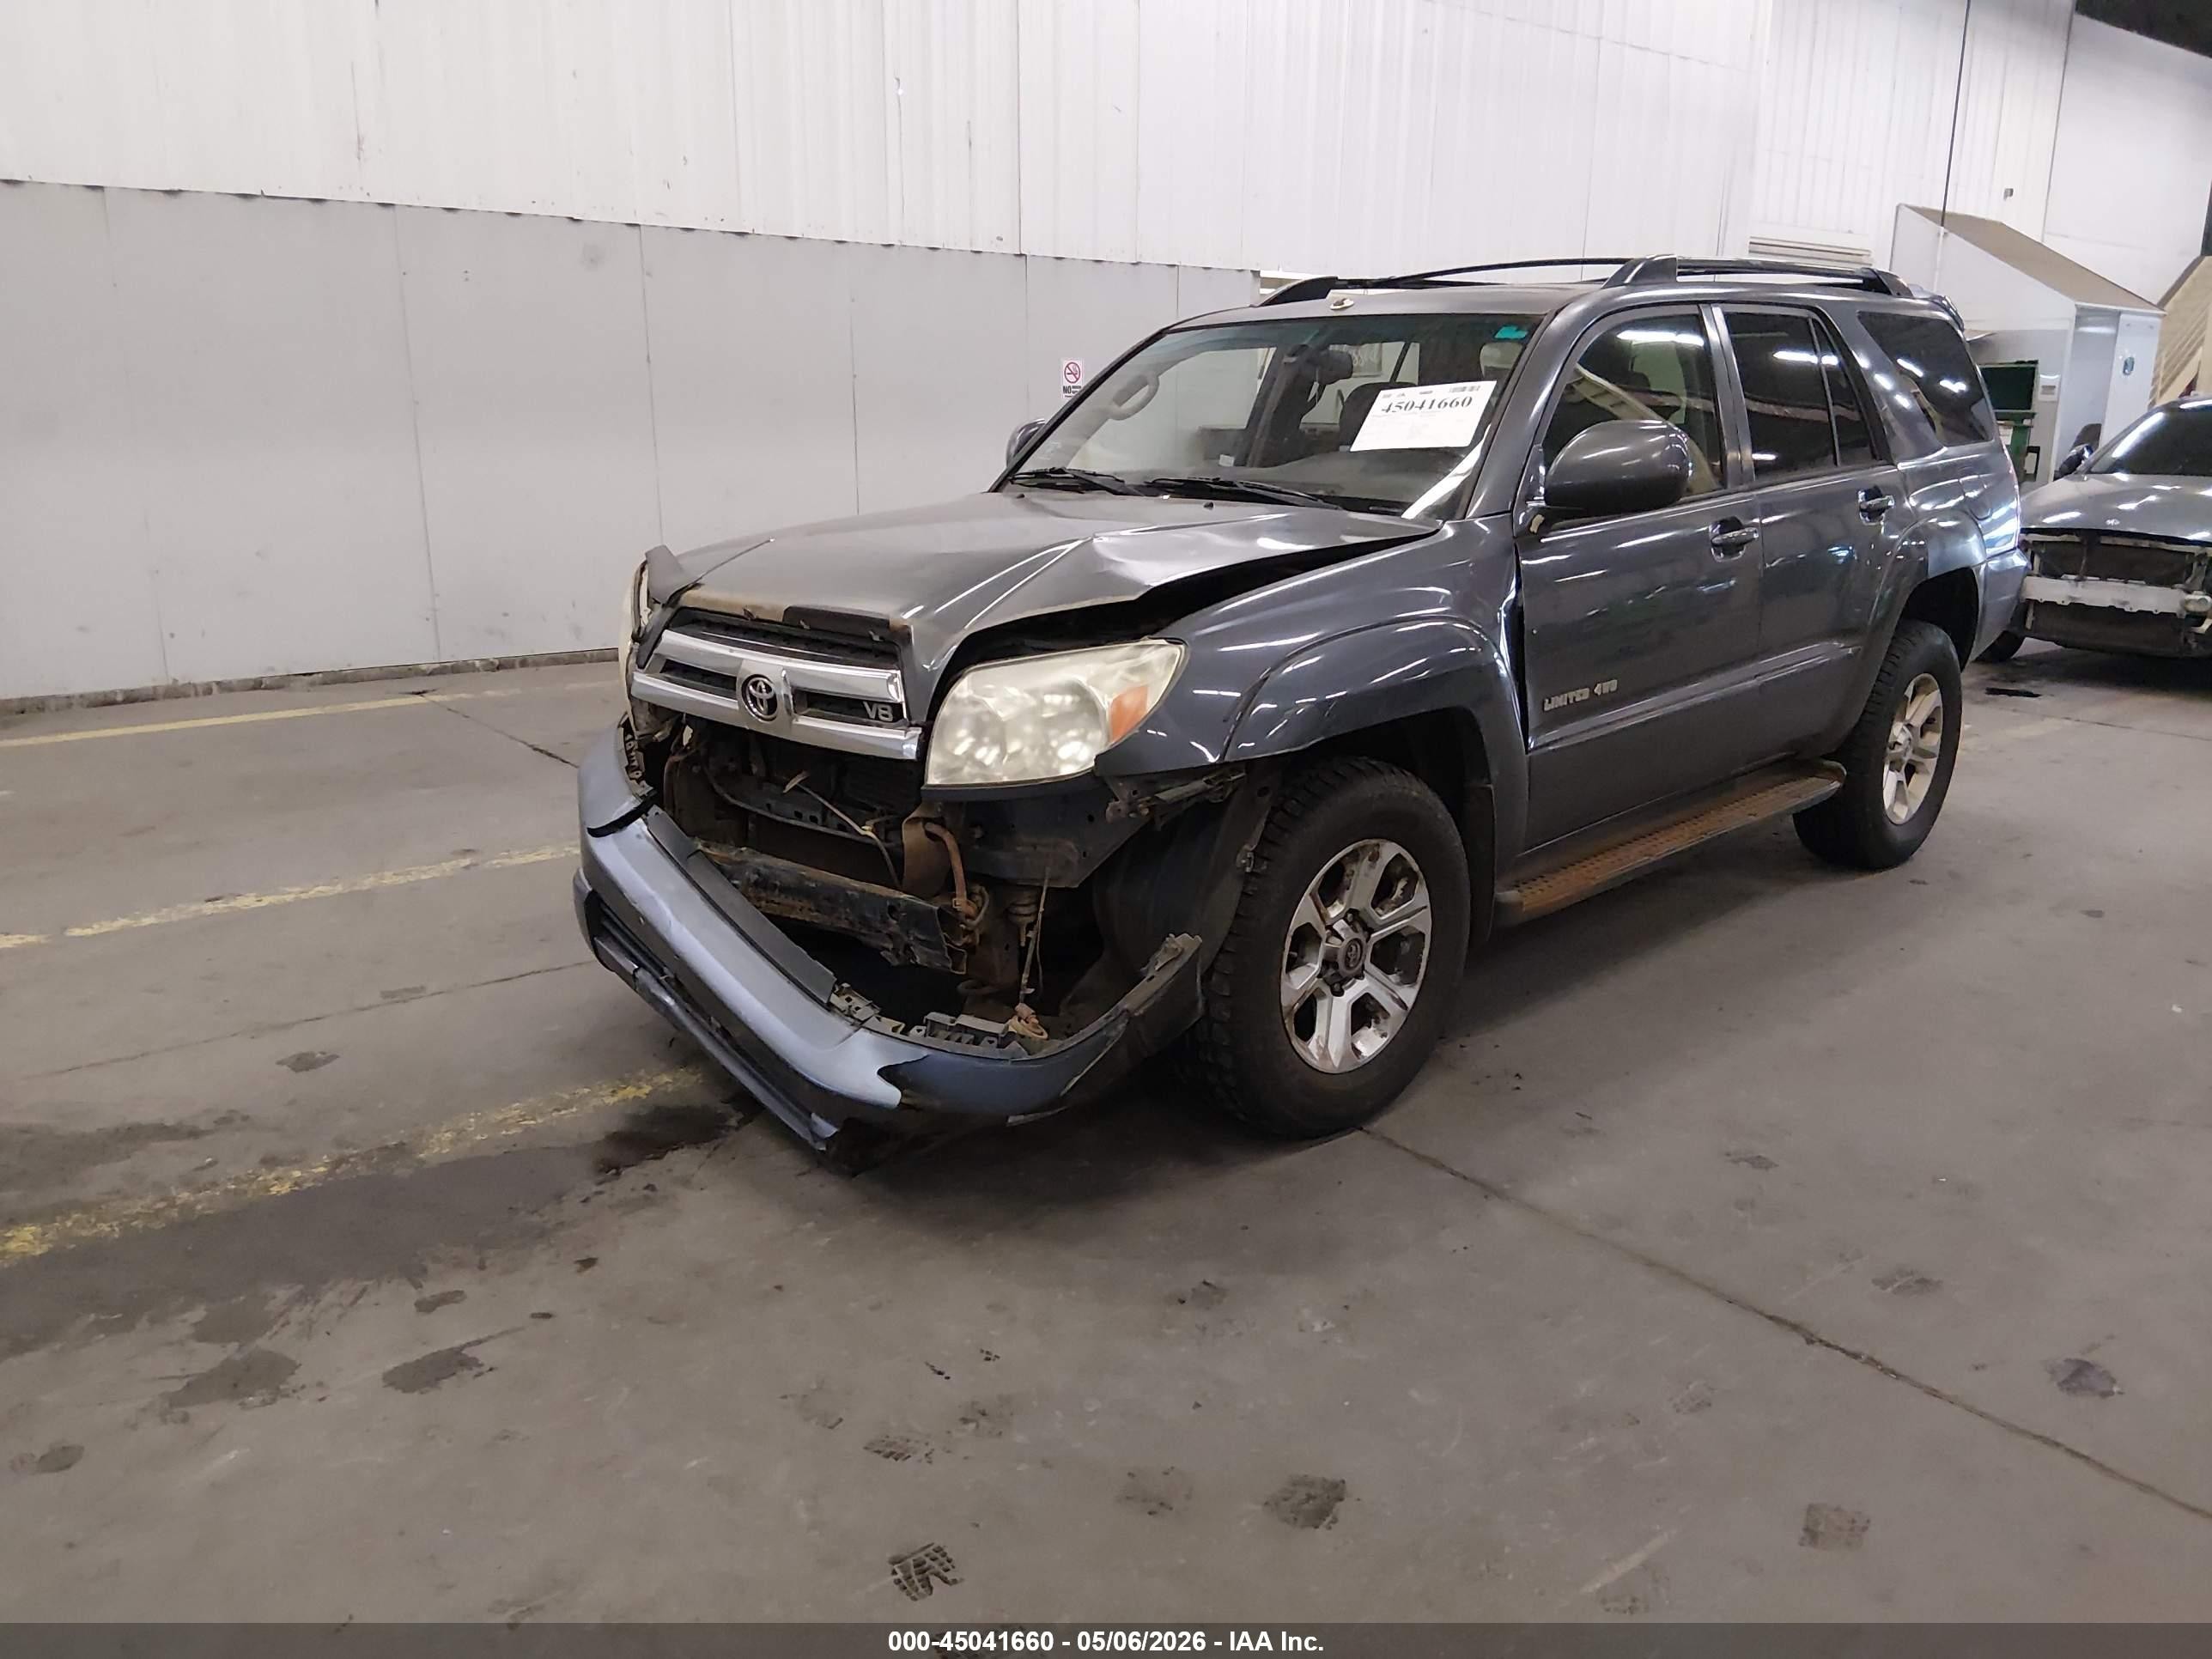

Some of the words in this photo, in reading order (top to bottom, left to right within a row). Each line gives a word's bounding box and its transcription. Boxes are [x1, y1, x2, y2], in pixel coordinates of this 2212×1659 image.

[1063, 386, 1072, 394] NO
[1382, 396, 1473, 413] 45041660
[1544, 687, 1590, 712] LIMITED
[863, 701, 894, 723] V8
